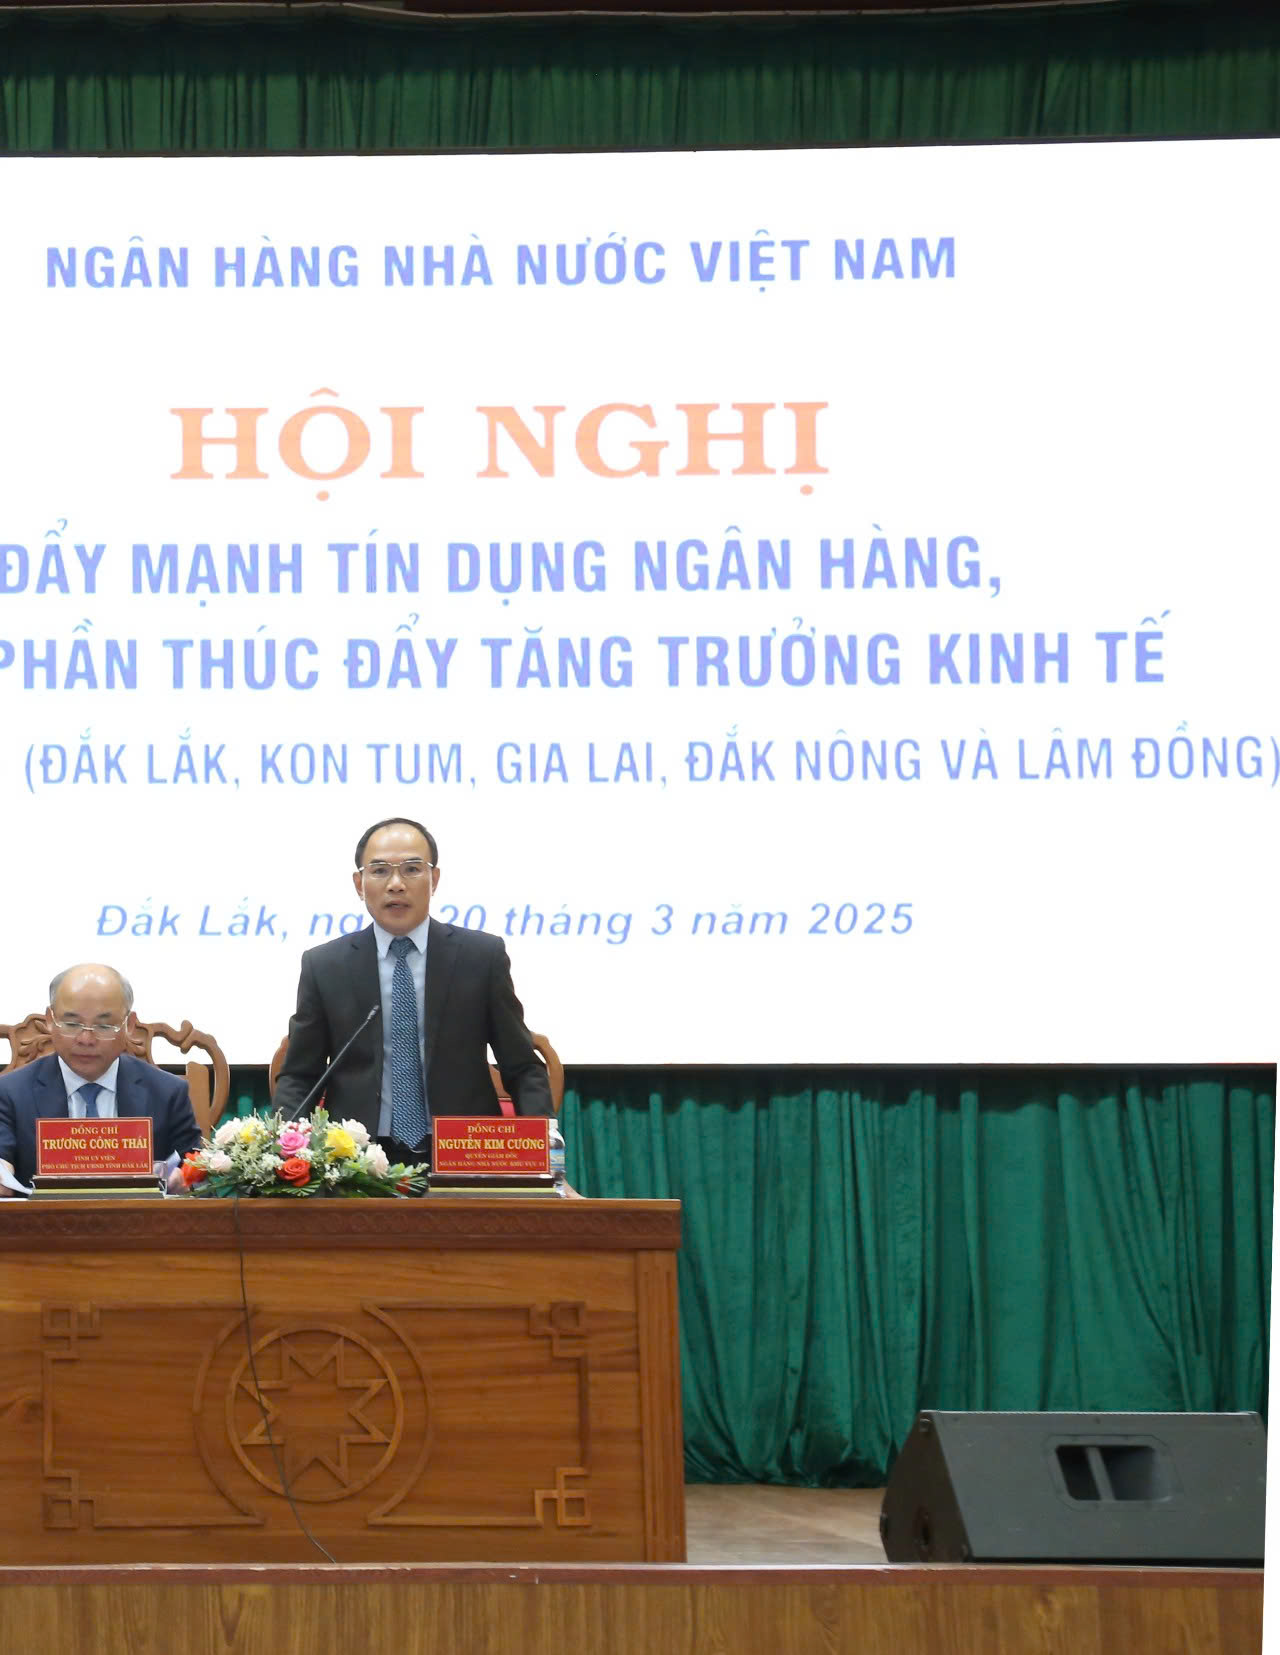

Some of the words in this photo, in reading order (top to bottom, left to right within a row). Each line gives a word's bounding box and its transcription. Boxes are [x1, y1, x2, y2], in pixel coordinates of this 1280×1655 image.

[48, 237, 188, 288] NGÂN
[215, 236, 358, 287] HÀNG
[385, 234, 492, 286] NHÀ
[518, 232, 665, 285] NƯỚC
[690, 230, 809, 293] VIỆT
[835, 238, 954, 280] NAM
[172, 389, 423, 501] HỘI
[477, 403, 827, 494] NGHỊ
[133, 544, 301, 606] MẠNH
[328, 529, 418, 592] TÍN
[448, 542, 605, 605] DỤNG
[635, 526, 790, 591] NGÂN
[821, 525, 1000, 597] HÀNG,
[163, 626, 318, 690] THÚC
[344, 614, 457, 688] ĐẨY
[481, 627, 632, 688] TĂNG
[658, 617, 899, 687] TRƯỞNG
[930, 632, 1068, 684] KINH
[1096, 610, 1170, 682] TẾ
[26, 728, 127, 792] (ĐẮK
[148, 728, 239, 790] LẮK,
[262, 744, 347, 784] KON
[367, 744, 476, 790] TUM,
[497, 743, 568, 783] GIA
[589, 742, 667, 788] LAI,
[685, 725, 774, 782] ĐẮK
[796, 730, 920, 781] NÔNG
[941, 729, 997, 780] VÀ
[1019, 728, 1111, 780] LÂM
[1132, 721, 1280, 784] ĐỒNG)
[97, 905, 179, 937] Đắk
[200, 905, 287, 941] Lắk,
[505, 904, 632, 945] tháng
[652, 904, 672, 936] 3
[692, 903, 788, 935] năm
[808, 903, 913, 935] 2025
[43, 1137, 86, 1150] TRƯƠNG
[89, 1136, 119, 1149] CÔNG
[122, 1135, 147, 1149] THÁI
[439, 1134, 481, 1150] NGUYỄN
[484, 1139, 505, 1150] KIM
